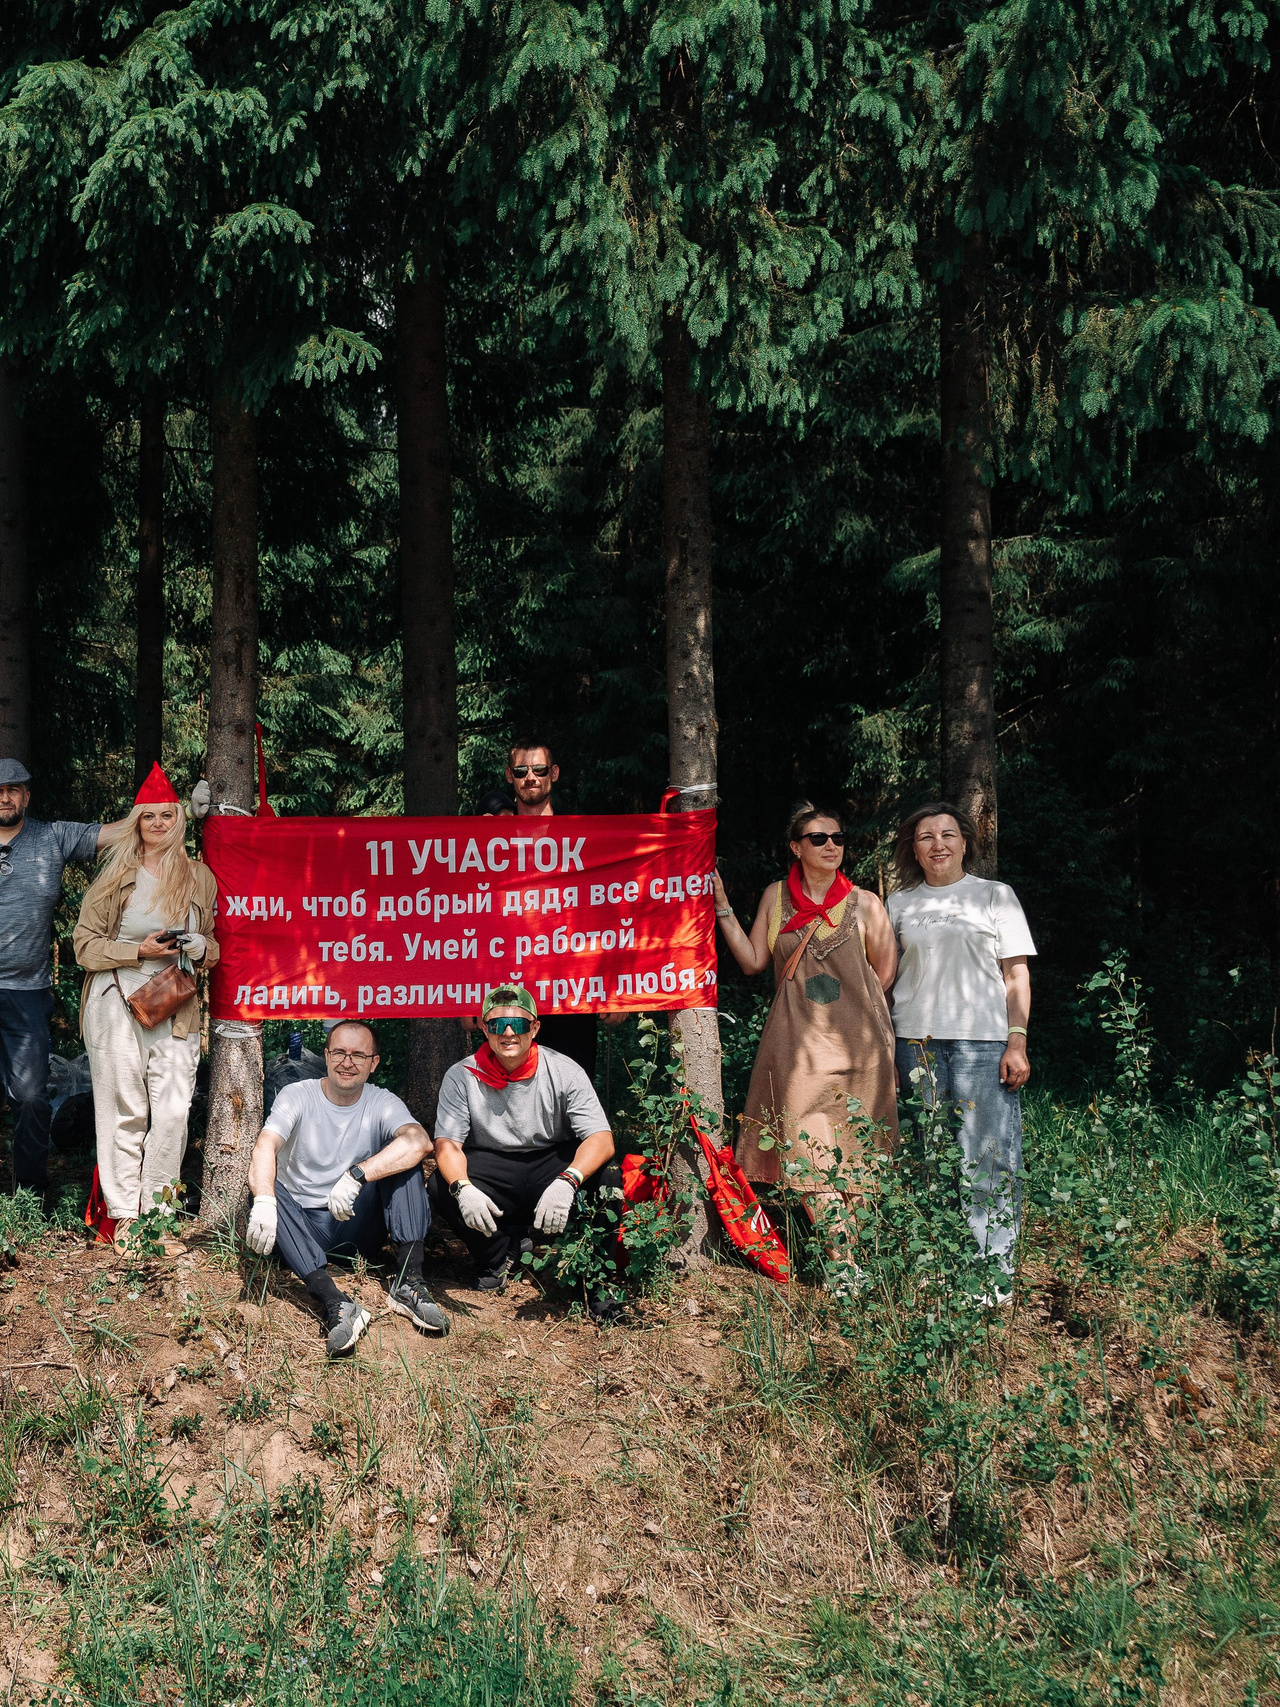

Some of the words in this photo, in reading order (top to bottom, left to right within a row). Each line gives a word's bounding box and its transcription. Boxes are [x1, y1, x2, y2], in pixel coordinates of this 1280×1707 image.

[366, 841, 394, 875] 11
[408, 837, 586, 875] УЧАСТОК
[226, 895, 292, 922] жди,
[303, 888, 366, 917] чтоб
[377, 883, 492, 922] добрый
[503, 885, 578, 916] дядя
[590, 880, 639, 905] все
[319, 934, 393, 962] тебя.
[403, 929, 478, 961] Умей
[489, 937, 505, 958] с
[516, 918, 635, 964] работой
[234, 985, 346, 1011] ладить,
[536, 976, 606, 1007] труд
